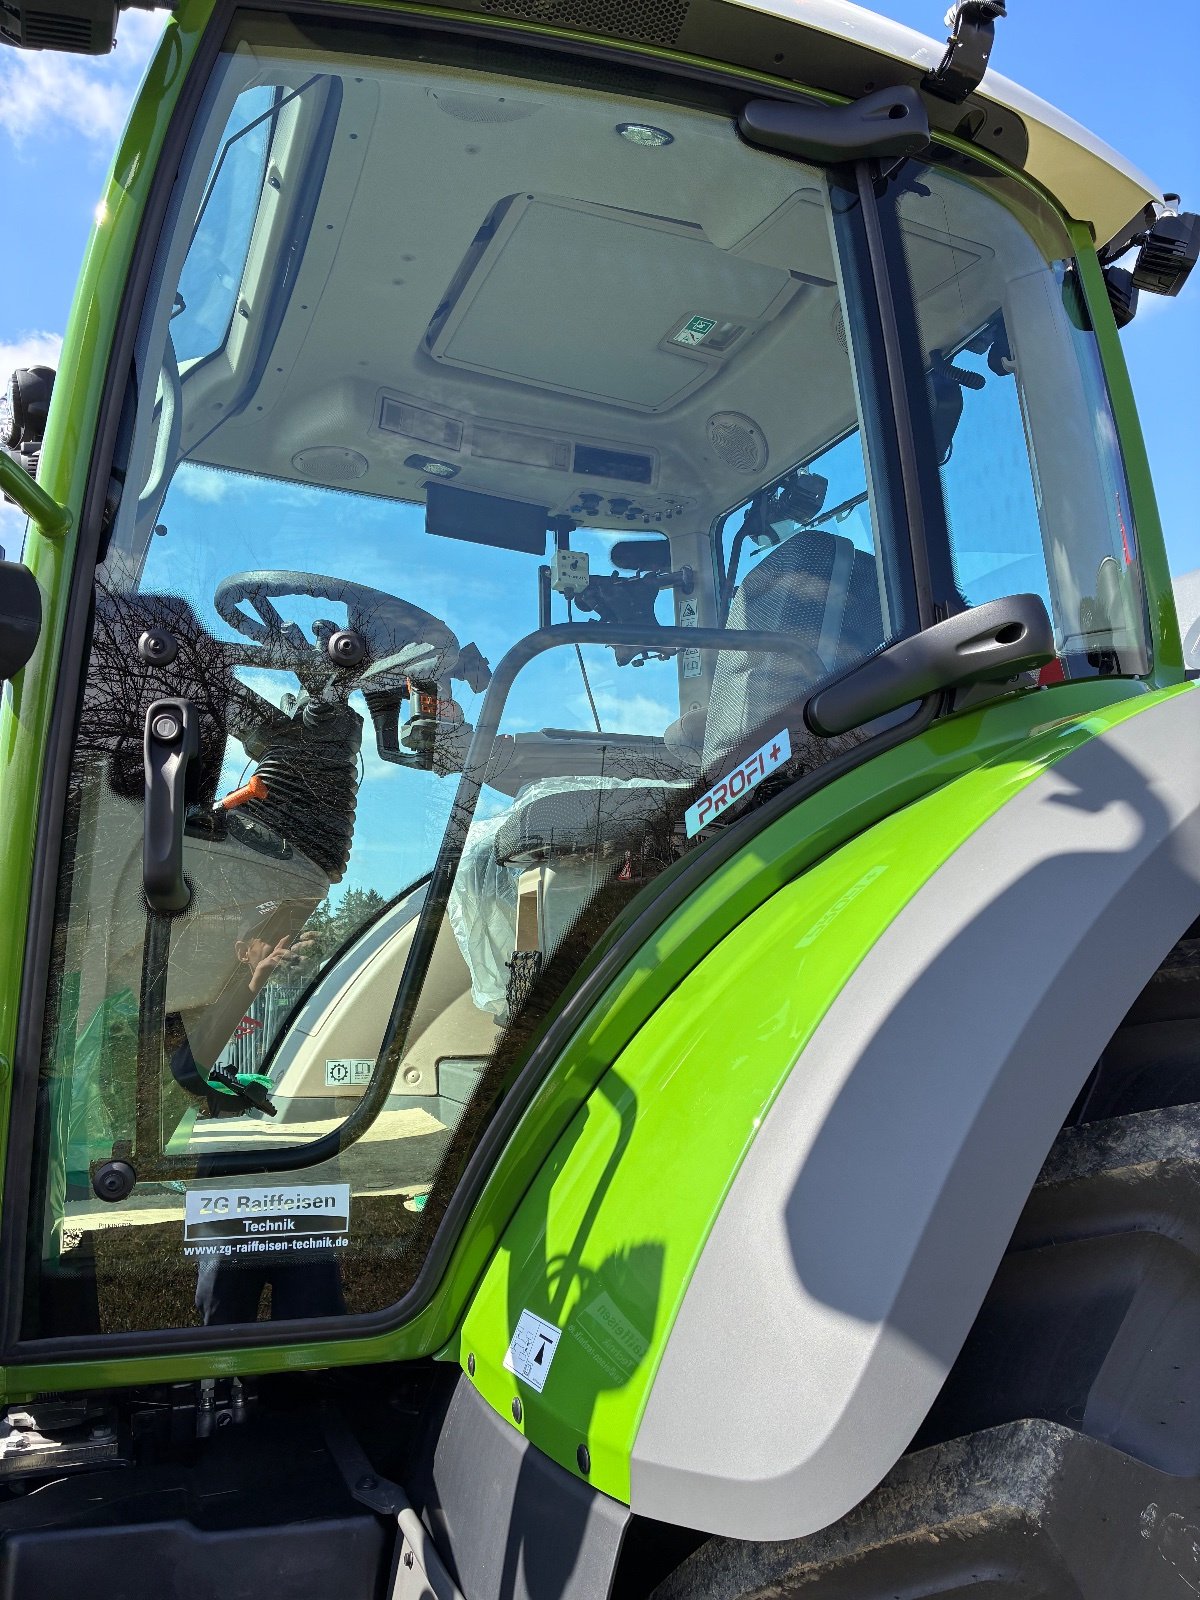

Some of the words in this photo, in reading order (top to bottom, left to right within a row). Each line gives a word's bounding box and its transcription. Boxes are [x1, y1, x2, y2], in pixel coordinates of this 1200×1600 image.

[697, 752, 765, 825] PROFI
[199, 1197, 230, 1215] ZG
[236, 1193, 336, 1214] Raiffeisen
[243, 1218, 296, 1233] Technik
[183, 1236, 349, 1256] www.zg-raiffeisen-technik.de
